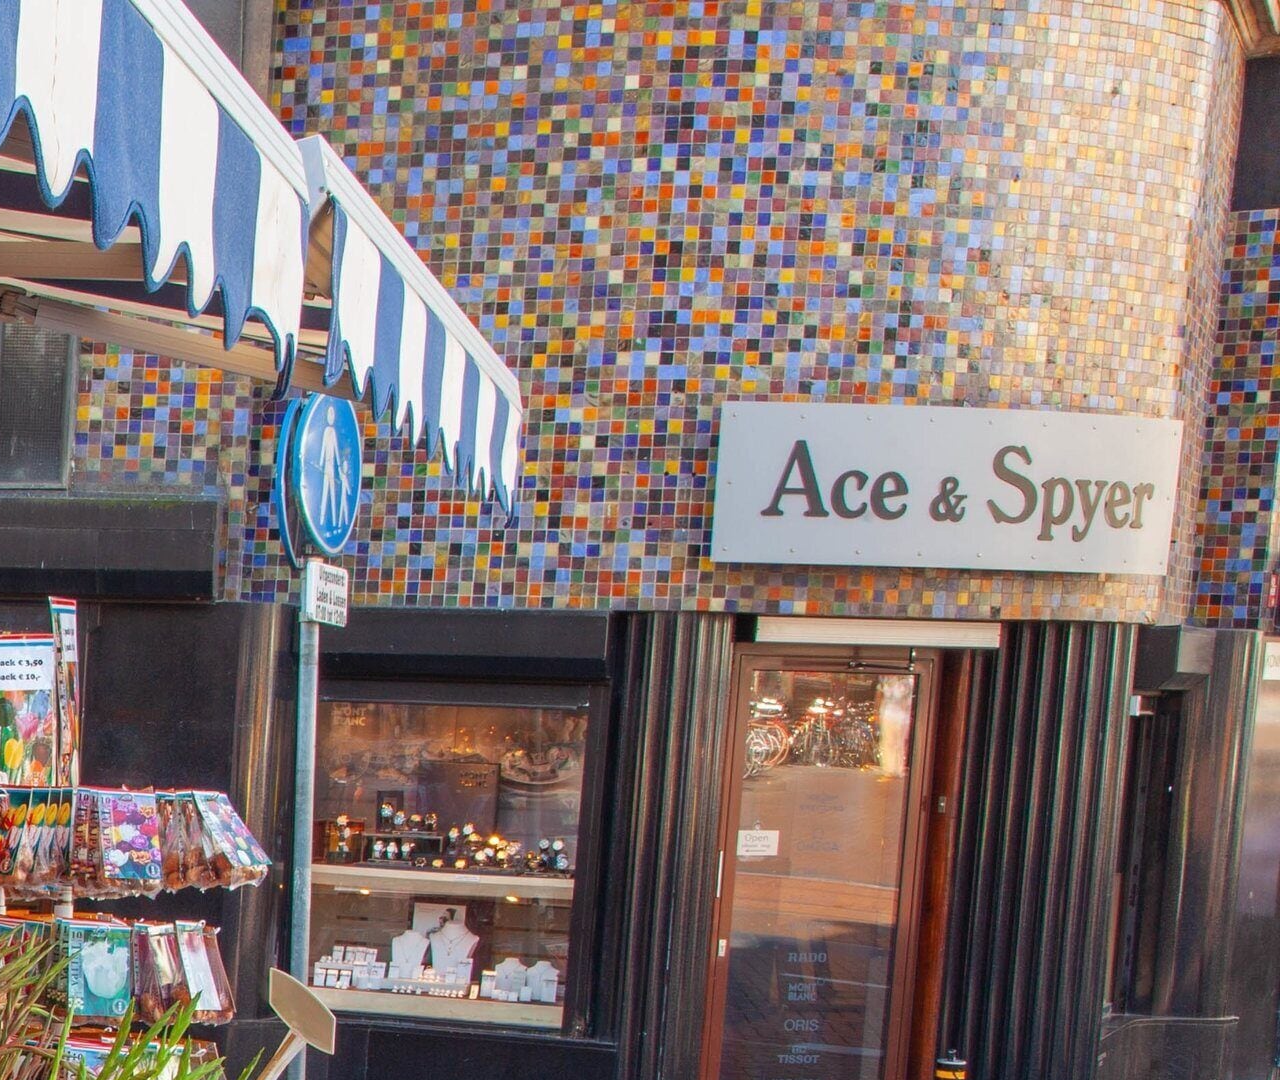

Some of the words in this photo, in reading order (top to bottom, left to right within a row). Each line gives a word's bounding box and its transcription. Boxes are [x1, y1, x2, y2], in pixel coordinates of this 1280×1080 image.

[760, 439, 908, 520] Ace
[928, 476, 967, 523] &
[987, 445, 1155, 542] Spyer
[25, 659, 44, 668] 3,50
[26, 673, 42, 681] 10,-
[744, 833, 769, 842] Open
[788, 952, 827, 963] RADO
[789, 982, 817, 992] MONT
[783, 1018, 820, 1032] ORIS
[777, 1054, 820, 1064] TISSOT
